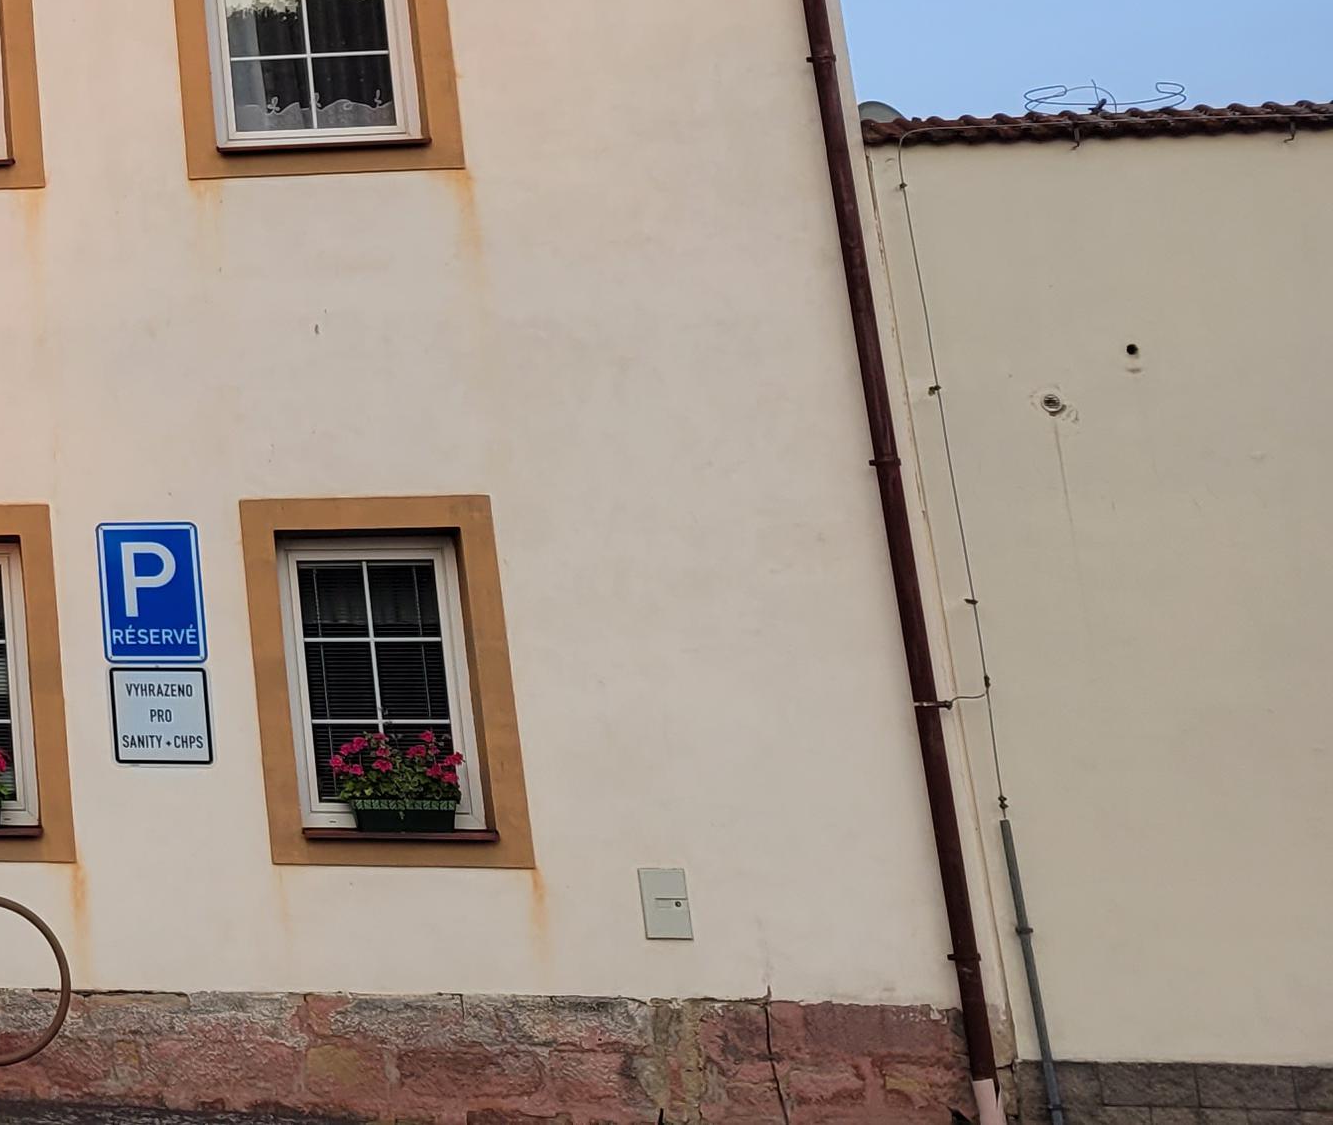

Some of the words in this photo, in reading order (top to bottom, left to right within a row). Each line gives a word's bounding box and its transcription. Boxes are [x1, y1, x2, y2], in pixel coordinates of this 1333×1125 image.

[120, 541, 177, 618] P
[112, 624, 198, 646] RÉSERVÉ
[125, 683, 193, 698] VYHRAZENO
[149, 709, 173, 723] PRO
[122, 735, 162, 749] SANITY
[173, 735, 204, 749] CHPS
